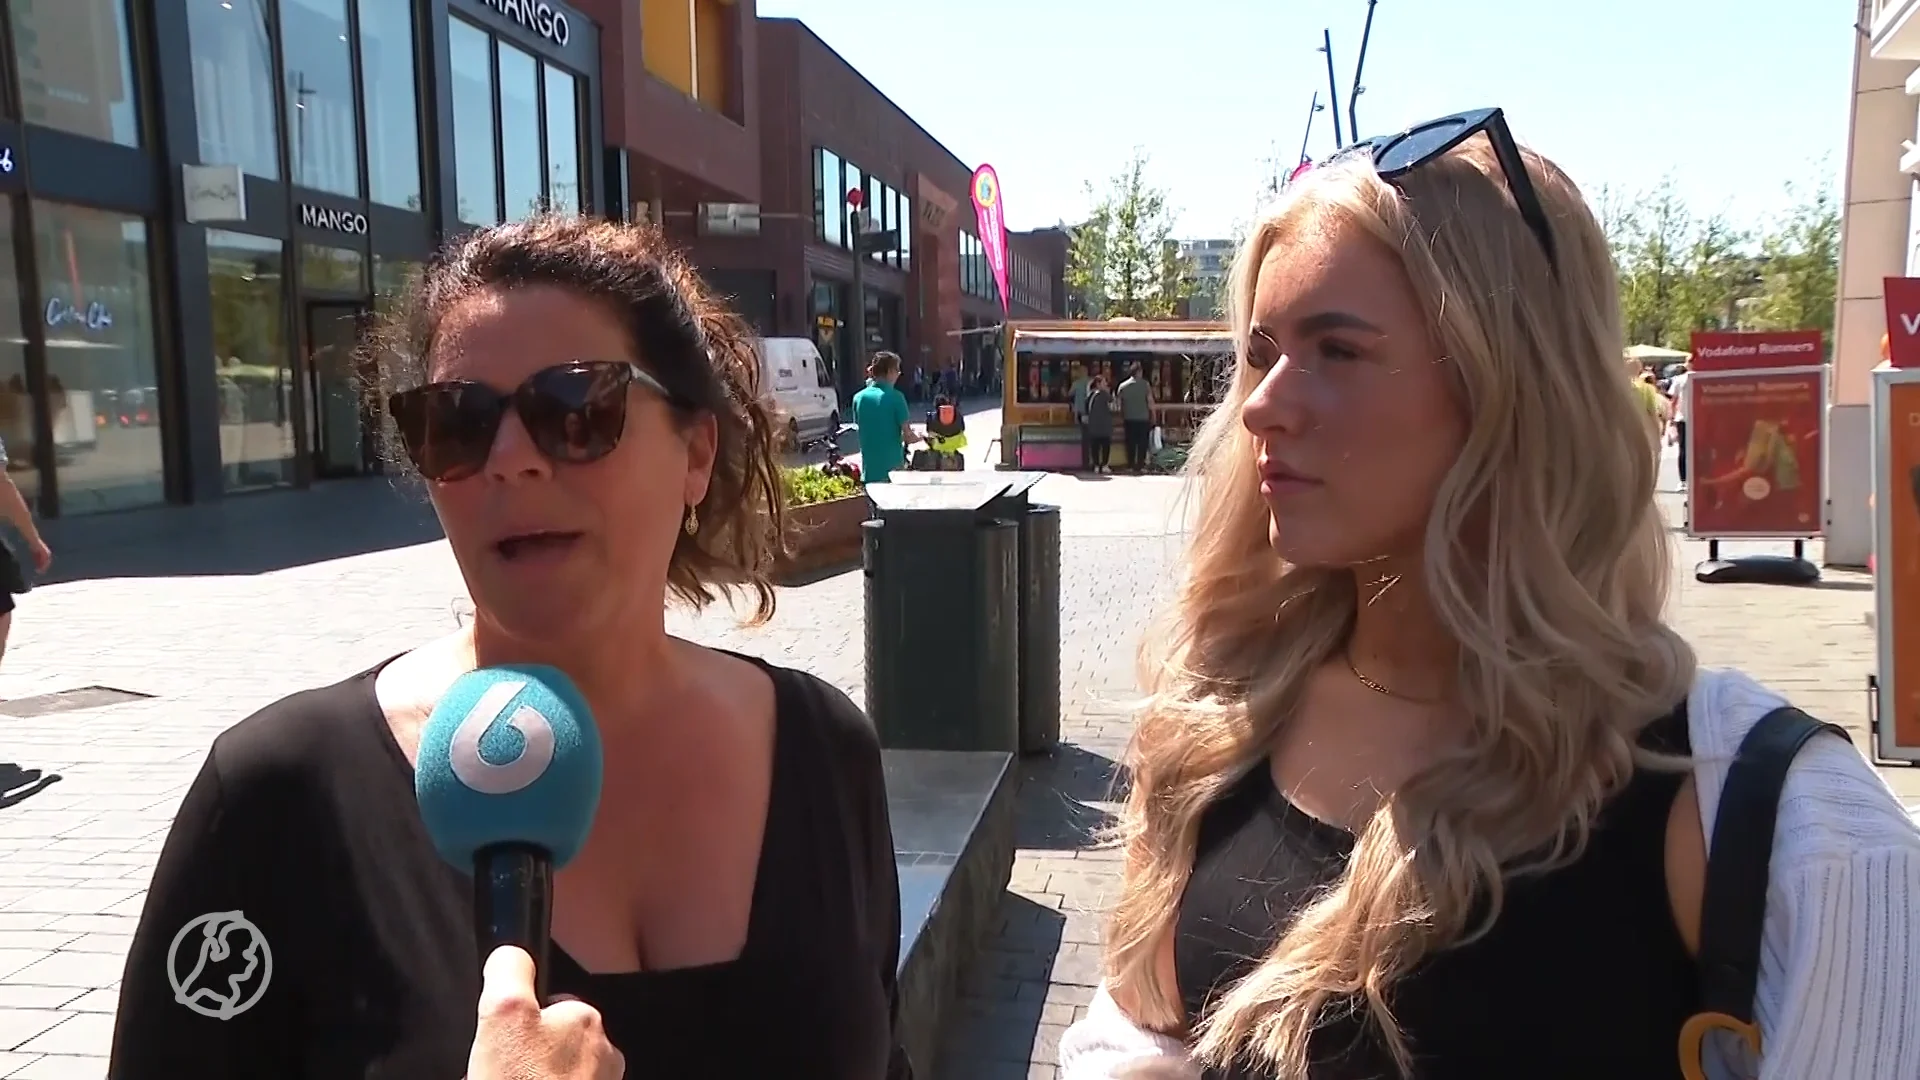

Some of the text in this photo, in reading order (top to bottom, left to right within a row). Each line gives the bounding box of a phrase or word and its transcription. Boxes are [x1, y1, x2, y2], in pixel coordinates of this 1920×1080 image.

[302, 204, 367, 235] MANGO
[1697, 343, 1815, 357] Vodafone Runners
[449, 681, 556, 794] 6
